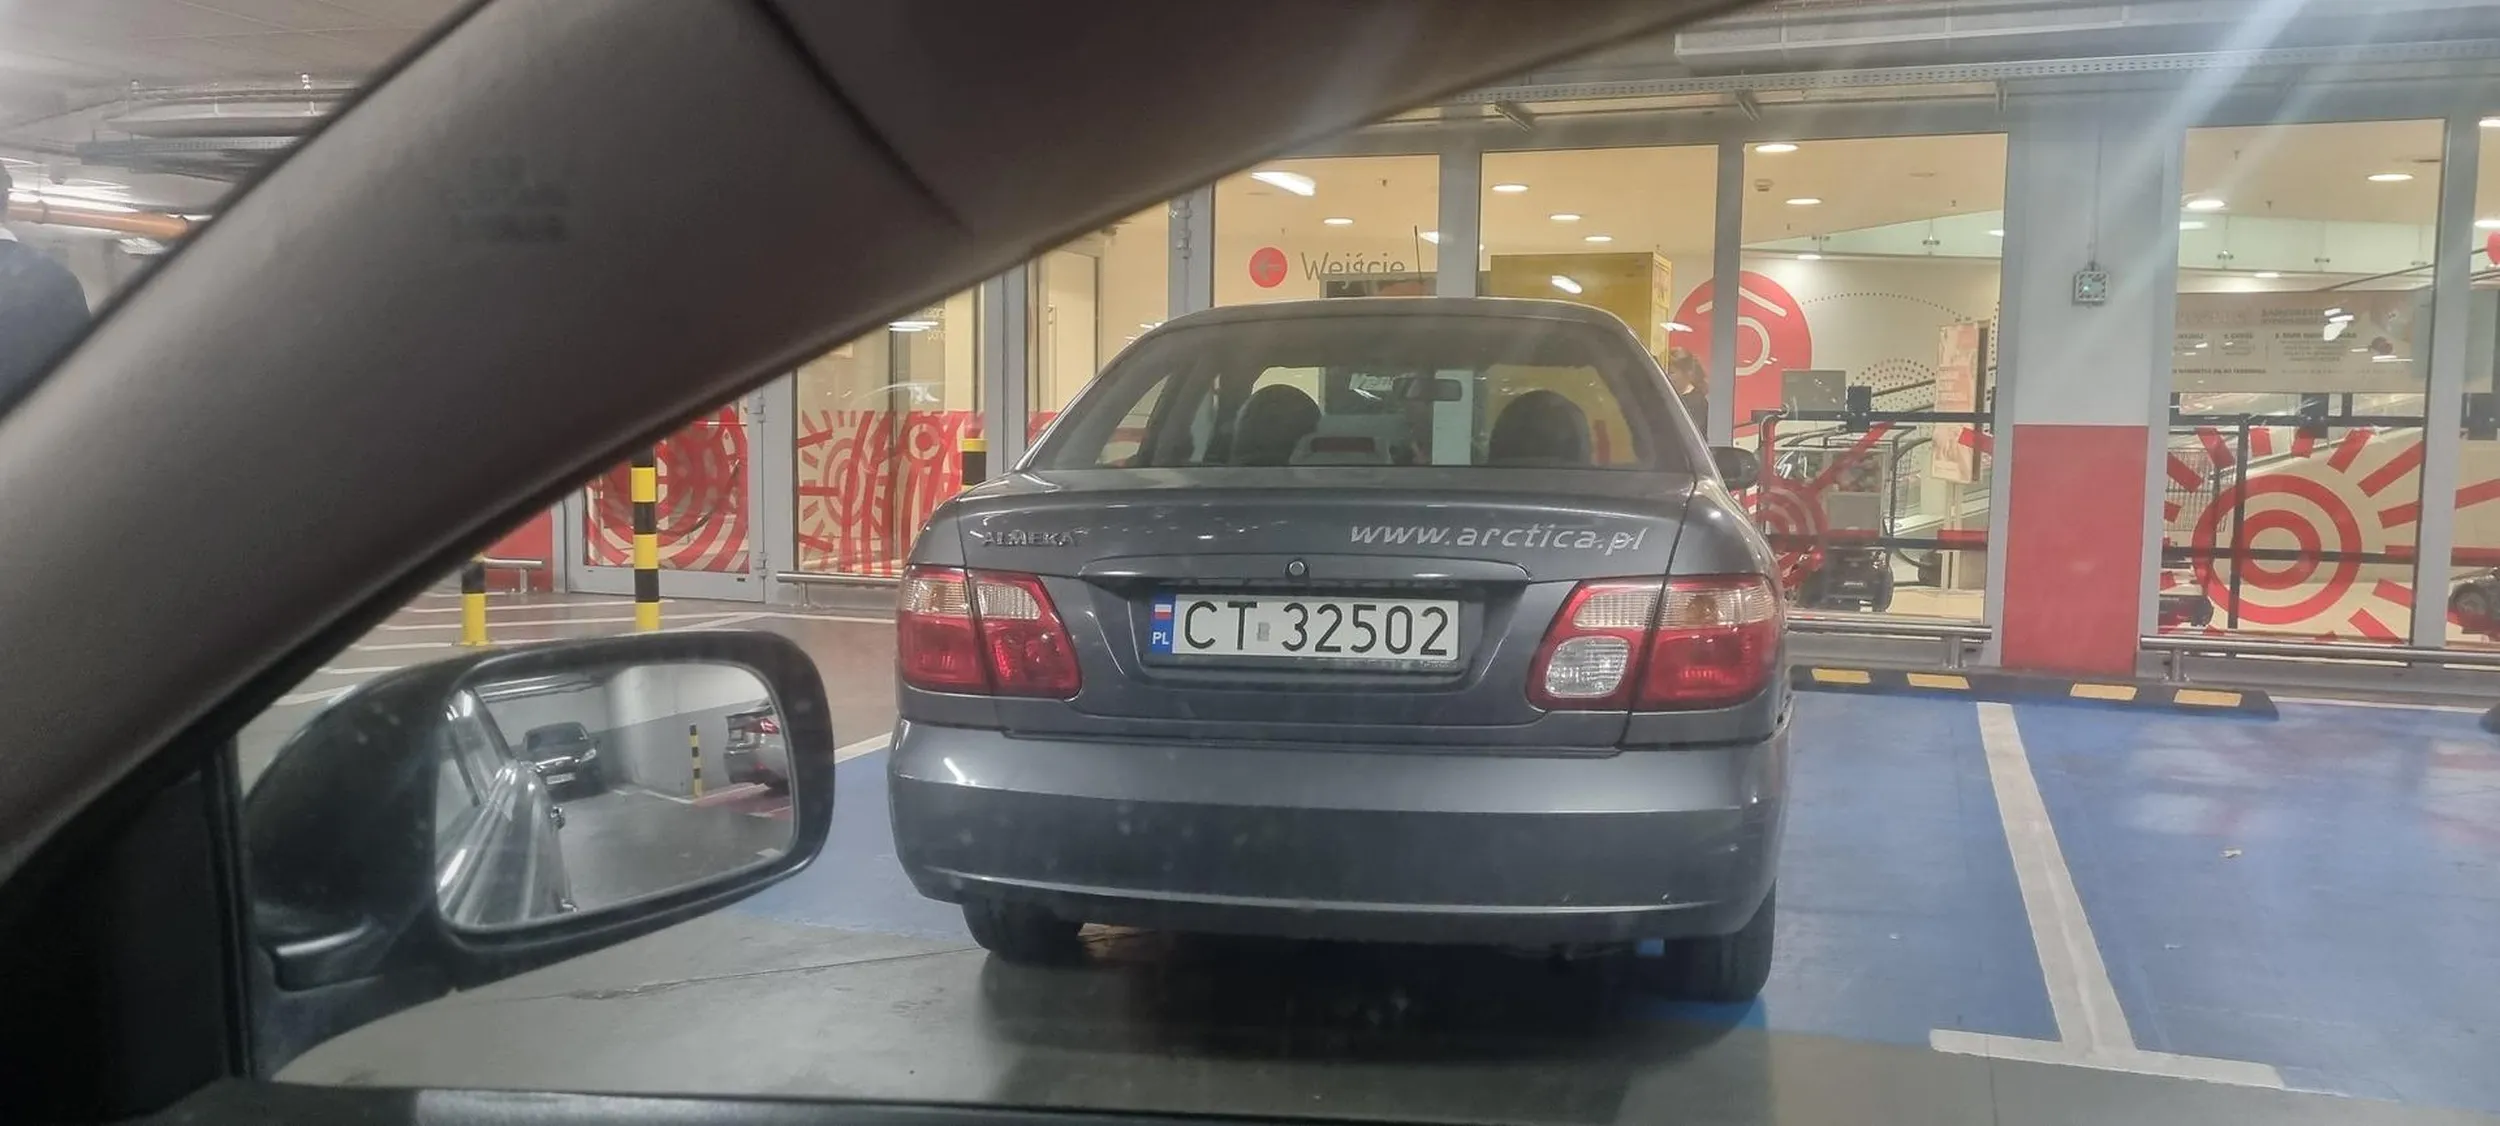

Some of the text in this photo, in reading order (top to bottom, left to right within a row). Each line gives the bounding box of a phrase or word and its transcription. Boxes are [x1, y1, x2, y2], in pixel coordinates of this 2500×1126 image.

[1300, 252, 1406, 290] Wejście
[1351, 523, 1648, 556] www.arctica.pl
[1151, 631, 1170, 646] PL
[1183, 600, 1449, 656] CT 32502
